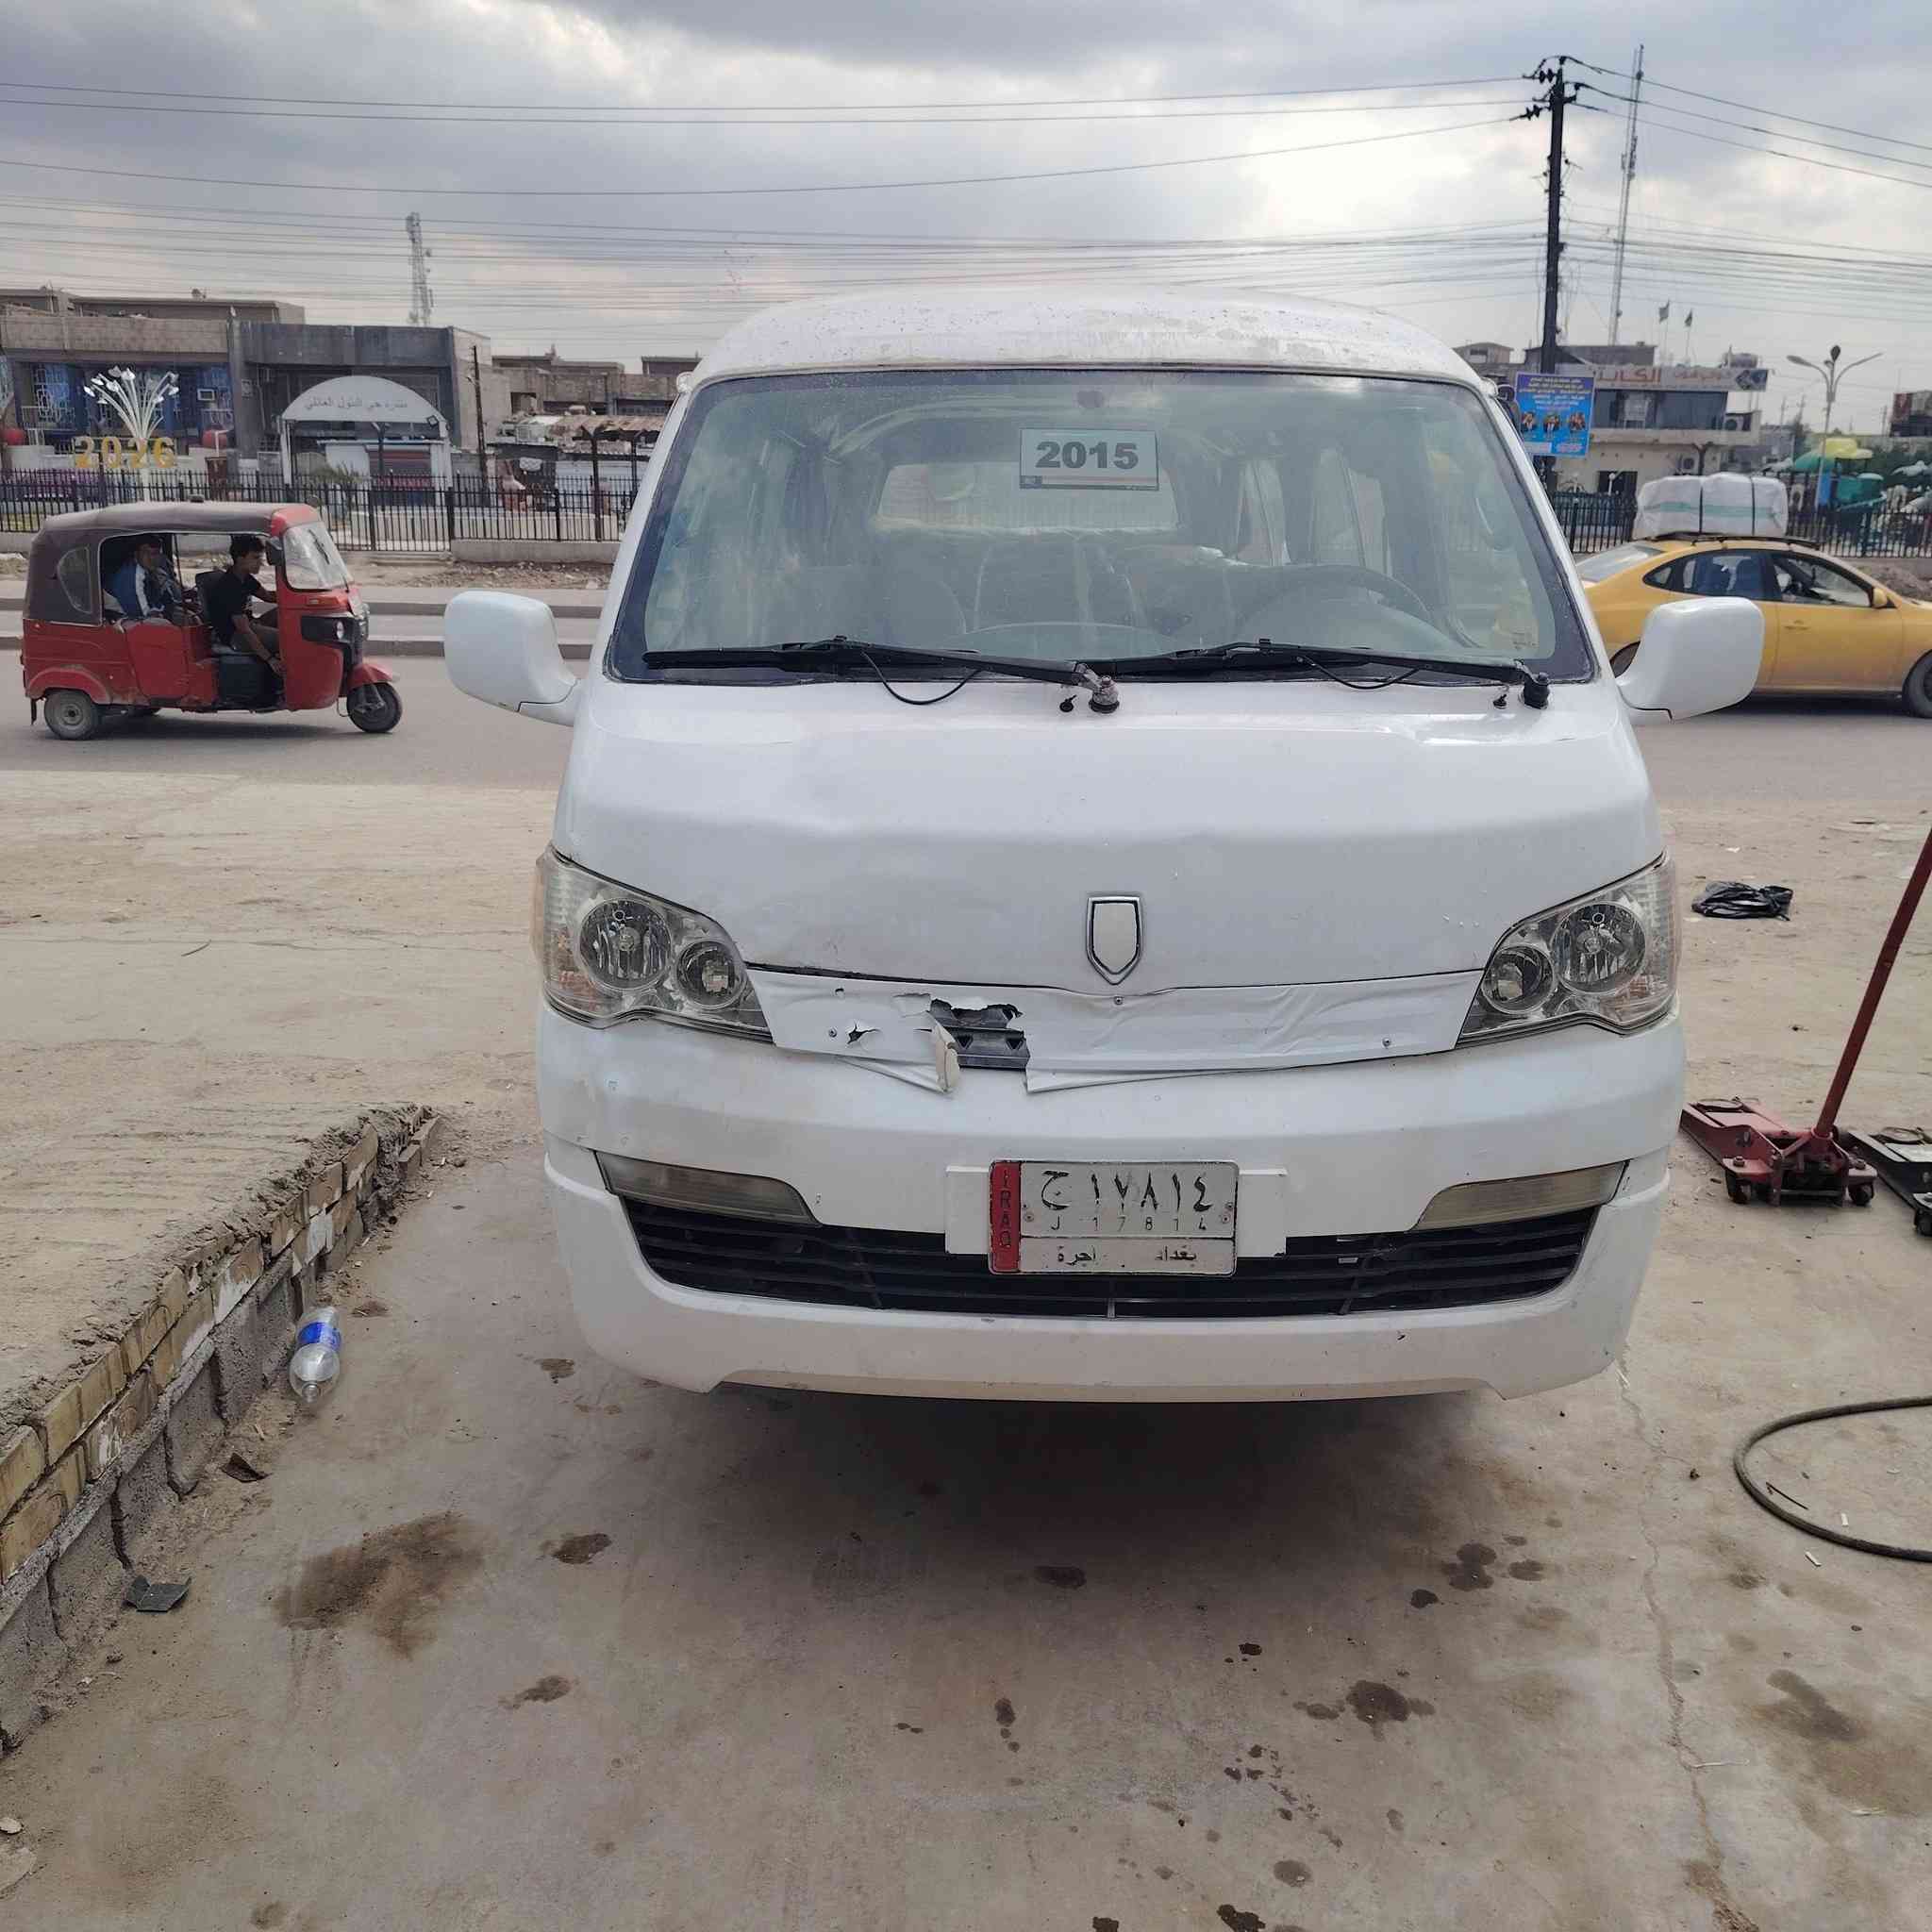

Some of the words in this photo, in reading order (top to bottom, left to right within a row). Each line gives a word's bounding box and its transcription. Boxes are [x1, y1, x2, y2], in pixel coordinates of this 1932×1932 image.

[74, 435, 175, 469] 2026
[1035, 441, 1140, 470] 2015
[999, 1169, 1013, 1249] IRAQ
[1090, 1171, 1214, 1213] ١٧٨١٤
